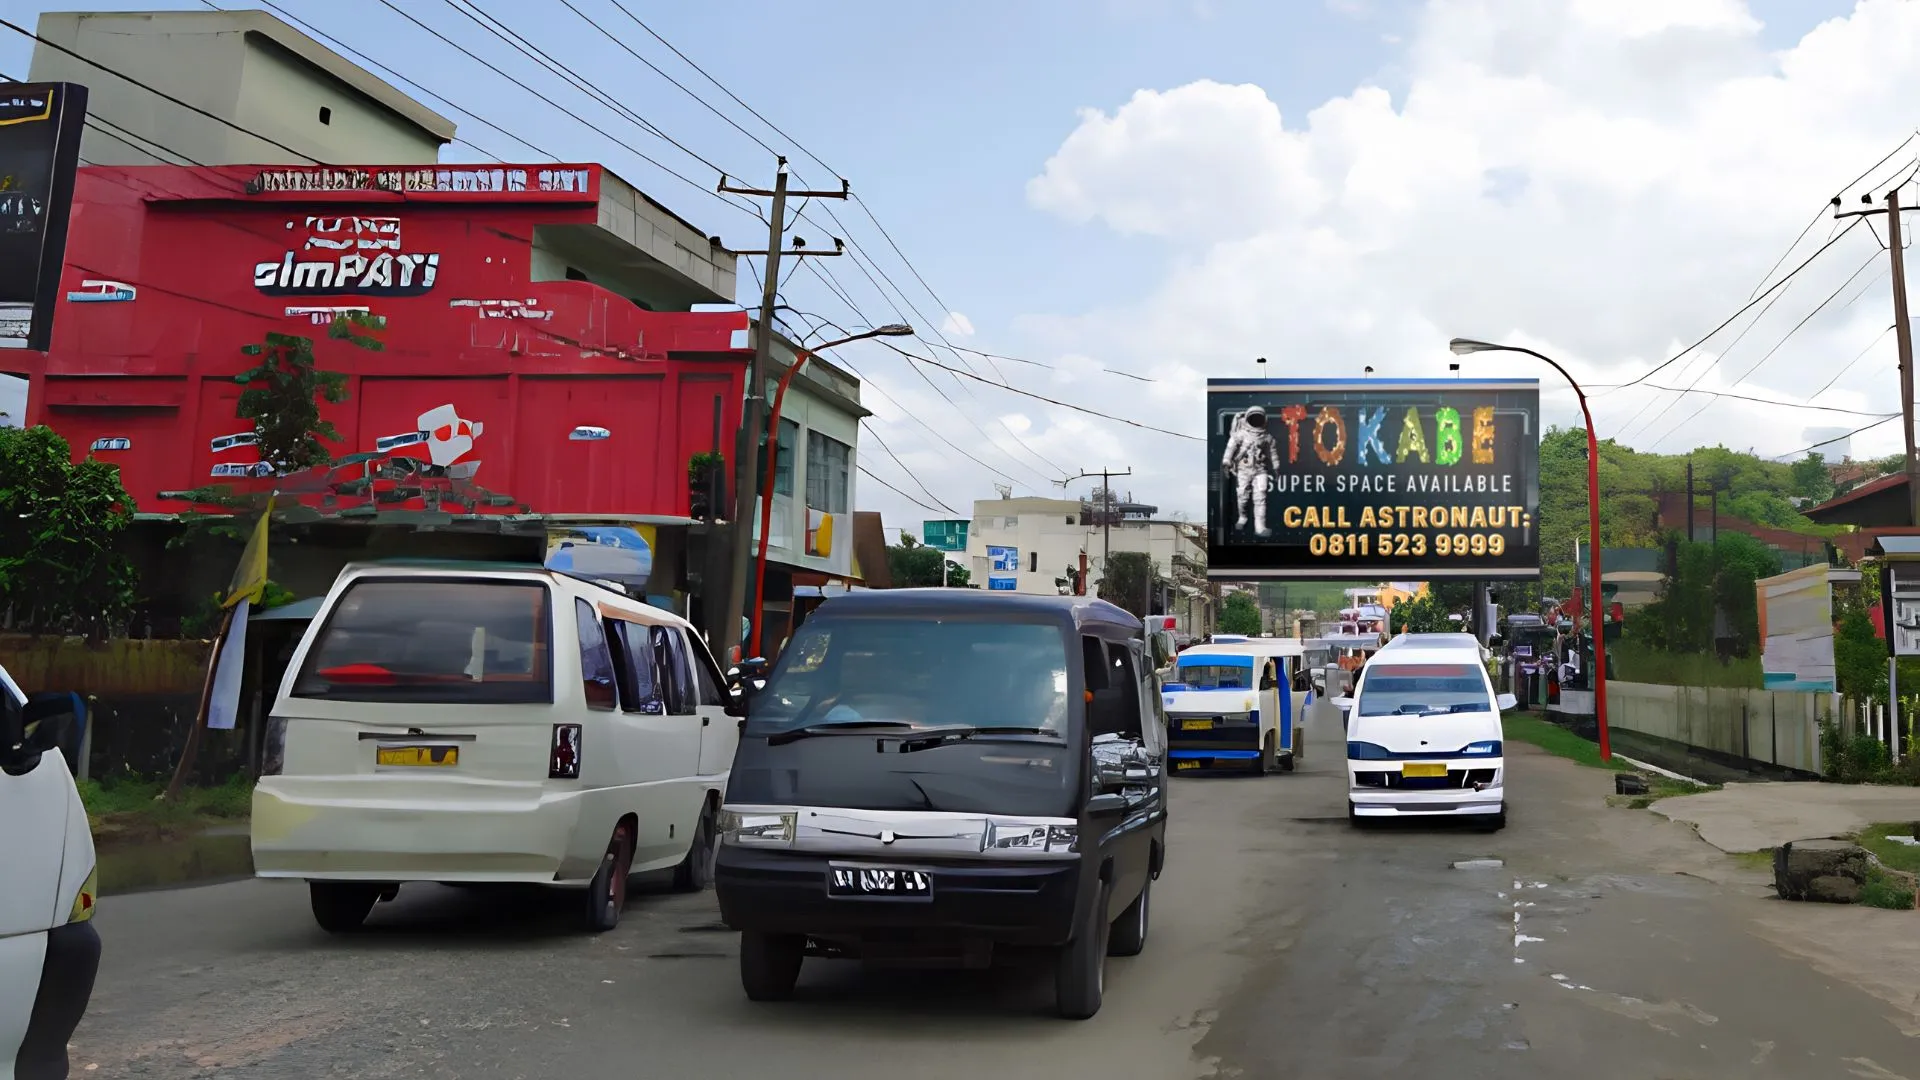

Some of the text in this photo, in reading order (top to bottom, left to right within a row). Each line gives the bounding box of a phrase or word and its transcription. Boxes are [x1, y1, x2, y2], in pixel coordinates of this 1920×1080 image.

[1281, 404, 1495, 466] TOKABE
[1267, 474, 1512, 492] SUPER SPACE AVAILABLE
[1283, 505, 1531, 528] CALL ASTRONAUT:
[1309, 533, 1505, 556] 0811 523 9999
